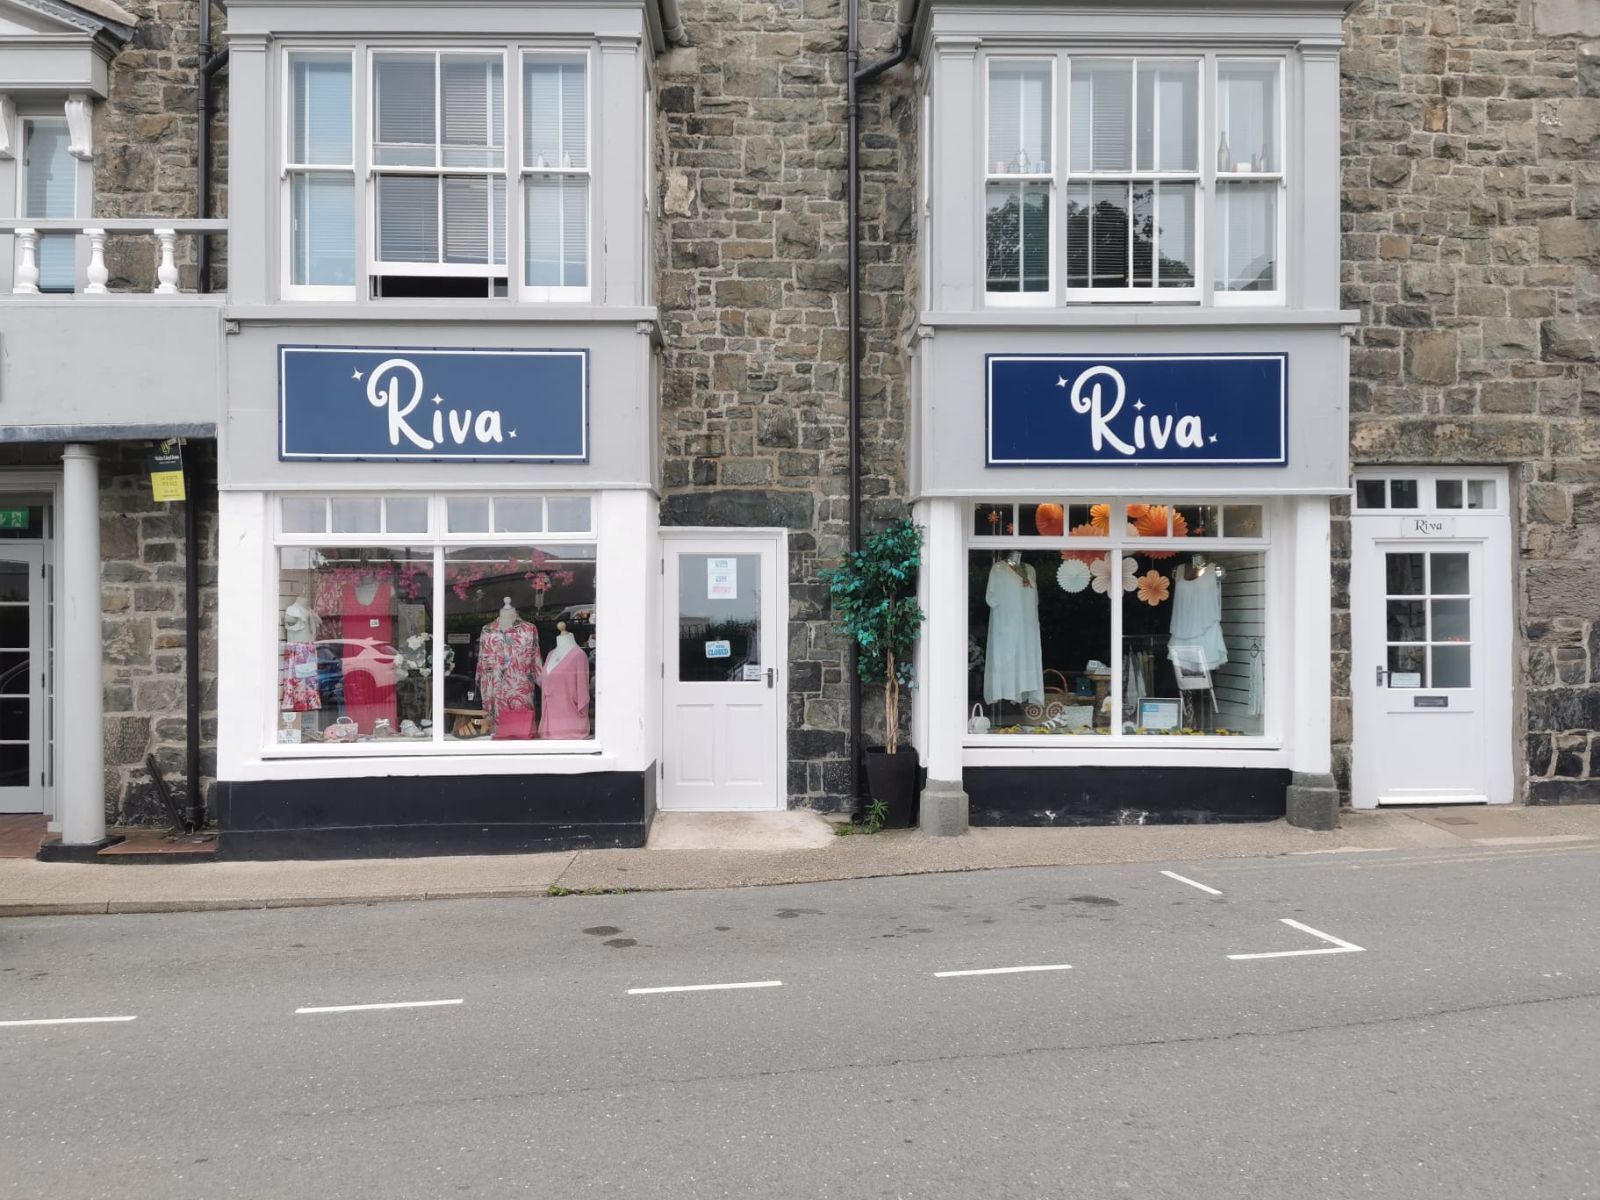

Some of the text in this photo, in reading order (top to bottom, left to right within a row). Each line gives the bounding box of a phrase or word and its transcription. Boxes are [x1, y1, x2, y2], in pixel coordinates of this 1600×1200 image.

[366, 358, 503, 450] Riva
[1070, 365, 1204, 455] Riva
[1414, 519, 1443, 535] Riva
